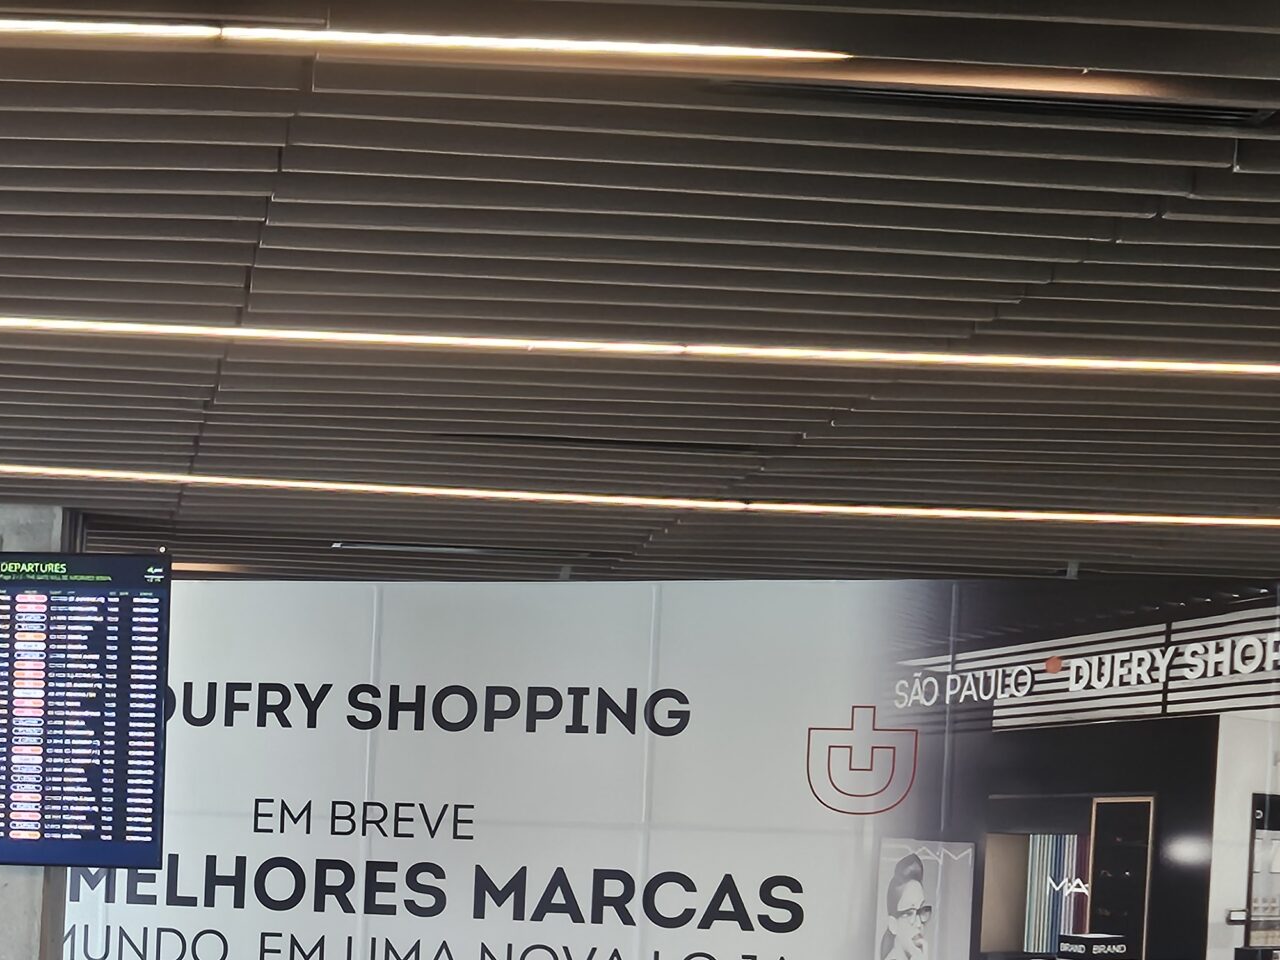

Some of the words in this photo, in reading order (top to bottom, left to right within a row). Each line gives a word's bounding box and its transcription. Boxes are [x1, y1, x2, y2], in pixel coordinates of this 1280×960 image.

[0, 562, 67, 574] DEPARTURES
[894, 671, 940, 709] SÃO
[945, 664, 1035, 705] PAULO
[1068, 645, 1178, 693] DUFRY
[345, 682, 692, 737] SHOPPING
[252, 798, 313, 835] EM
[328, 799, 476, 840] BREVE
[68, 853, 447, 918] MELHORES
[472, 863, 805, 934] MARCAS
[1092, 944, 1127, 955] BRAND
